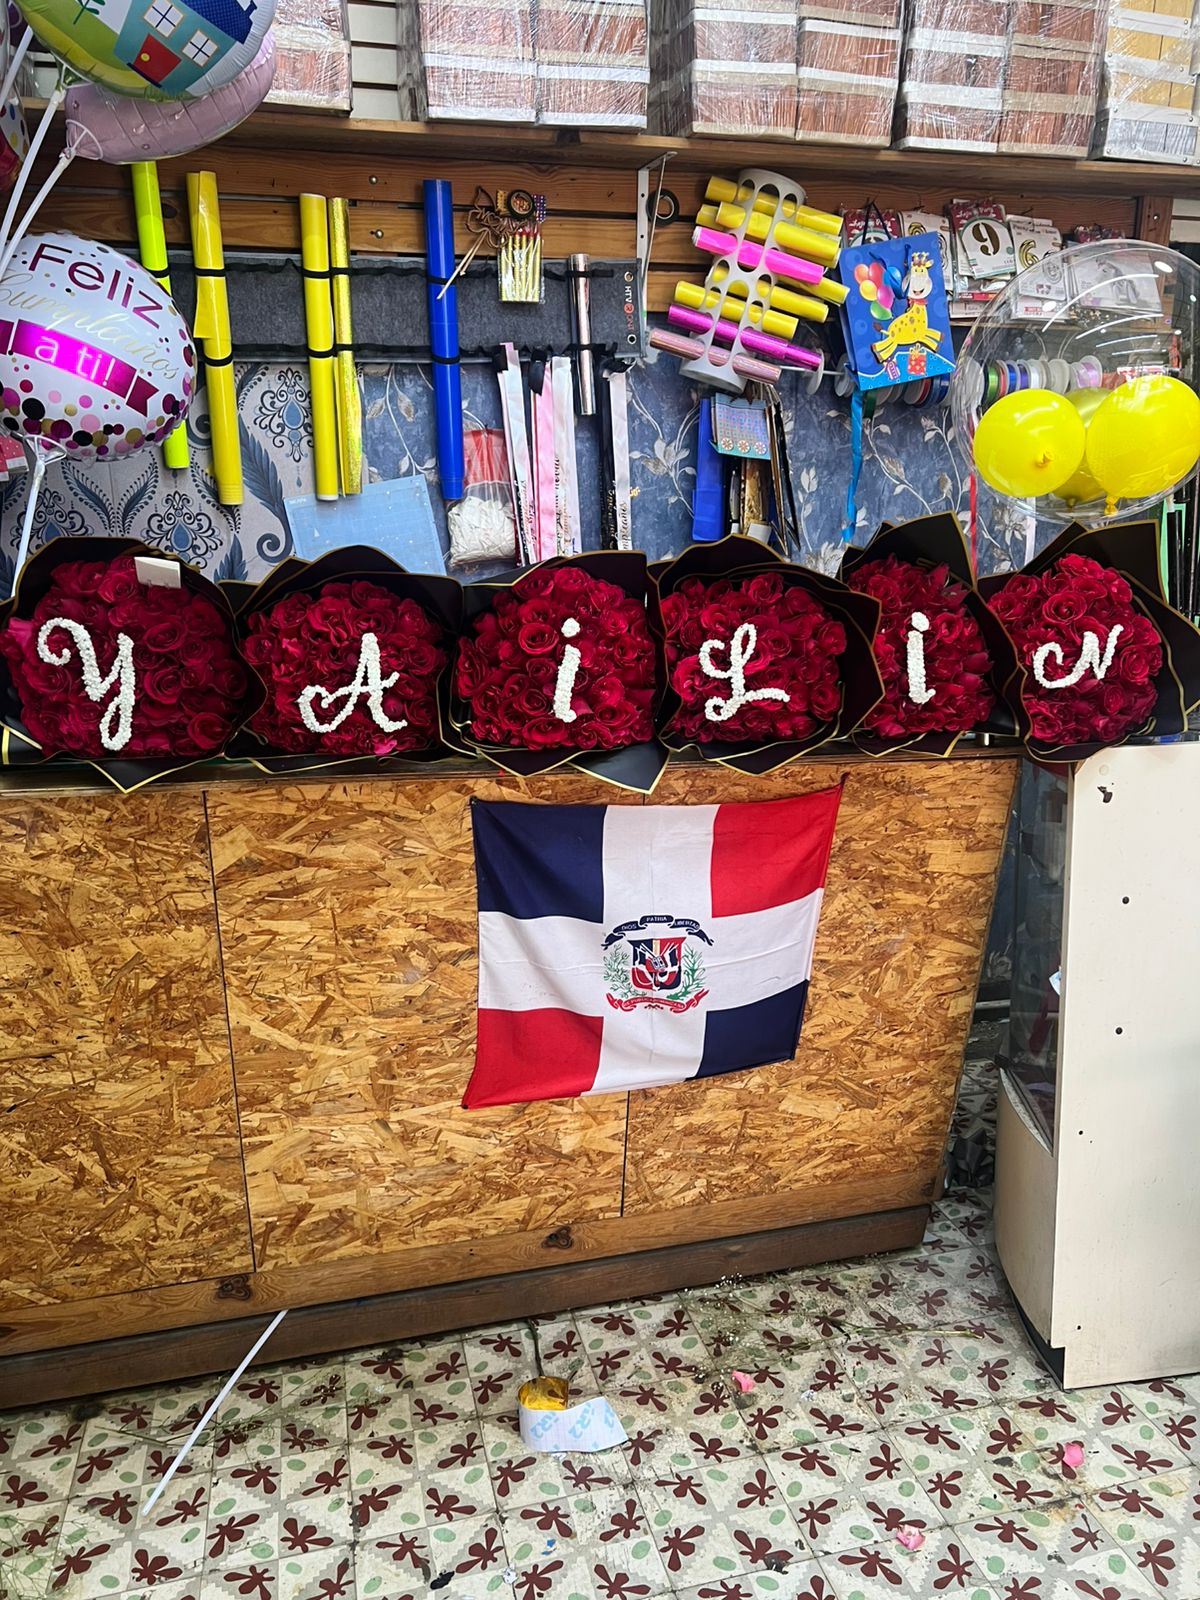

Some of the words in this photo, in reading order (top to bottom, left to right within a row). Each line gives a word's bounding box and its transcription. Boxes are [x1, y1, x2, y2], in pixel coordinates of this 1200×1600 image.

[972, 222, 1001, 256] 9
[28, 243, 163, 330] Feliz
[34, 335, 60, 365] a
[75, 346, 116, 387] ti!
